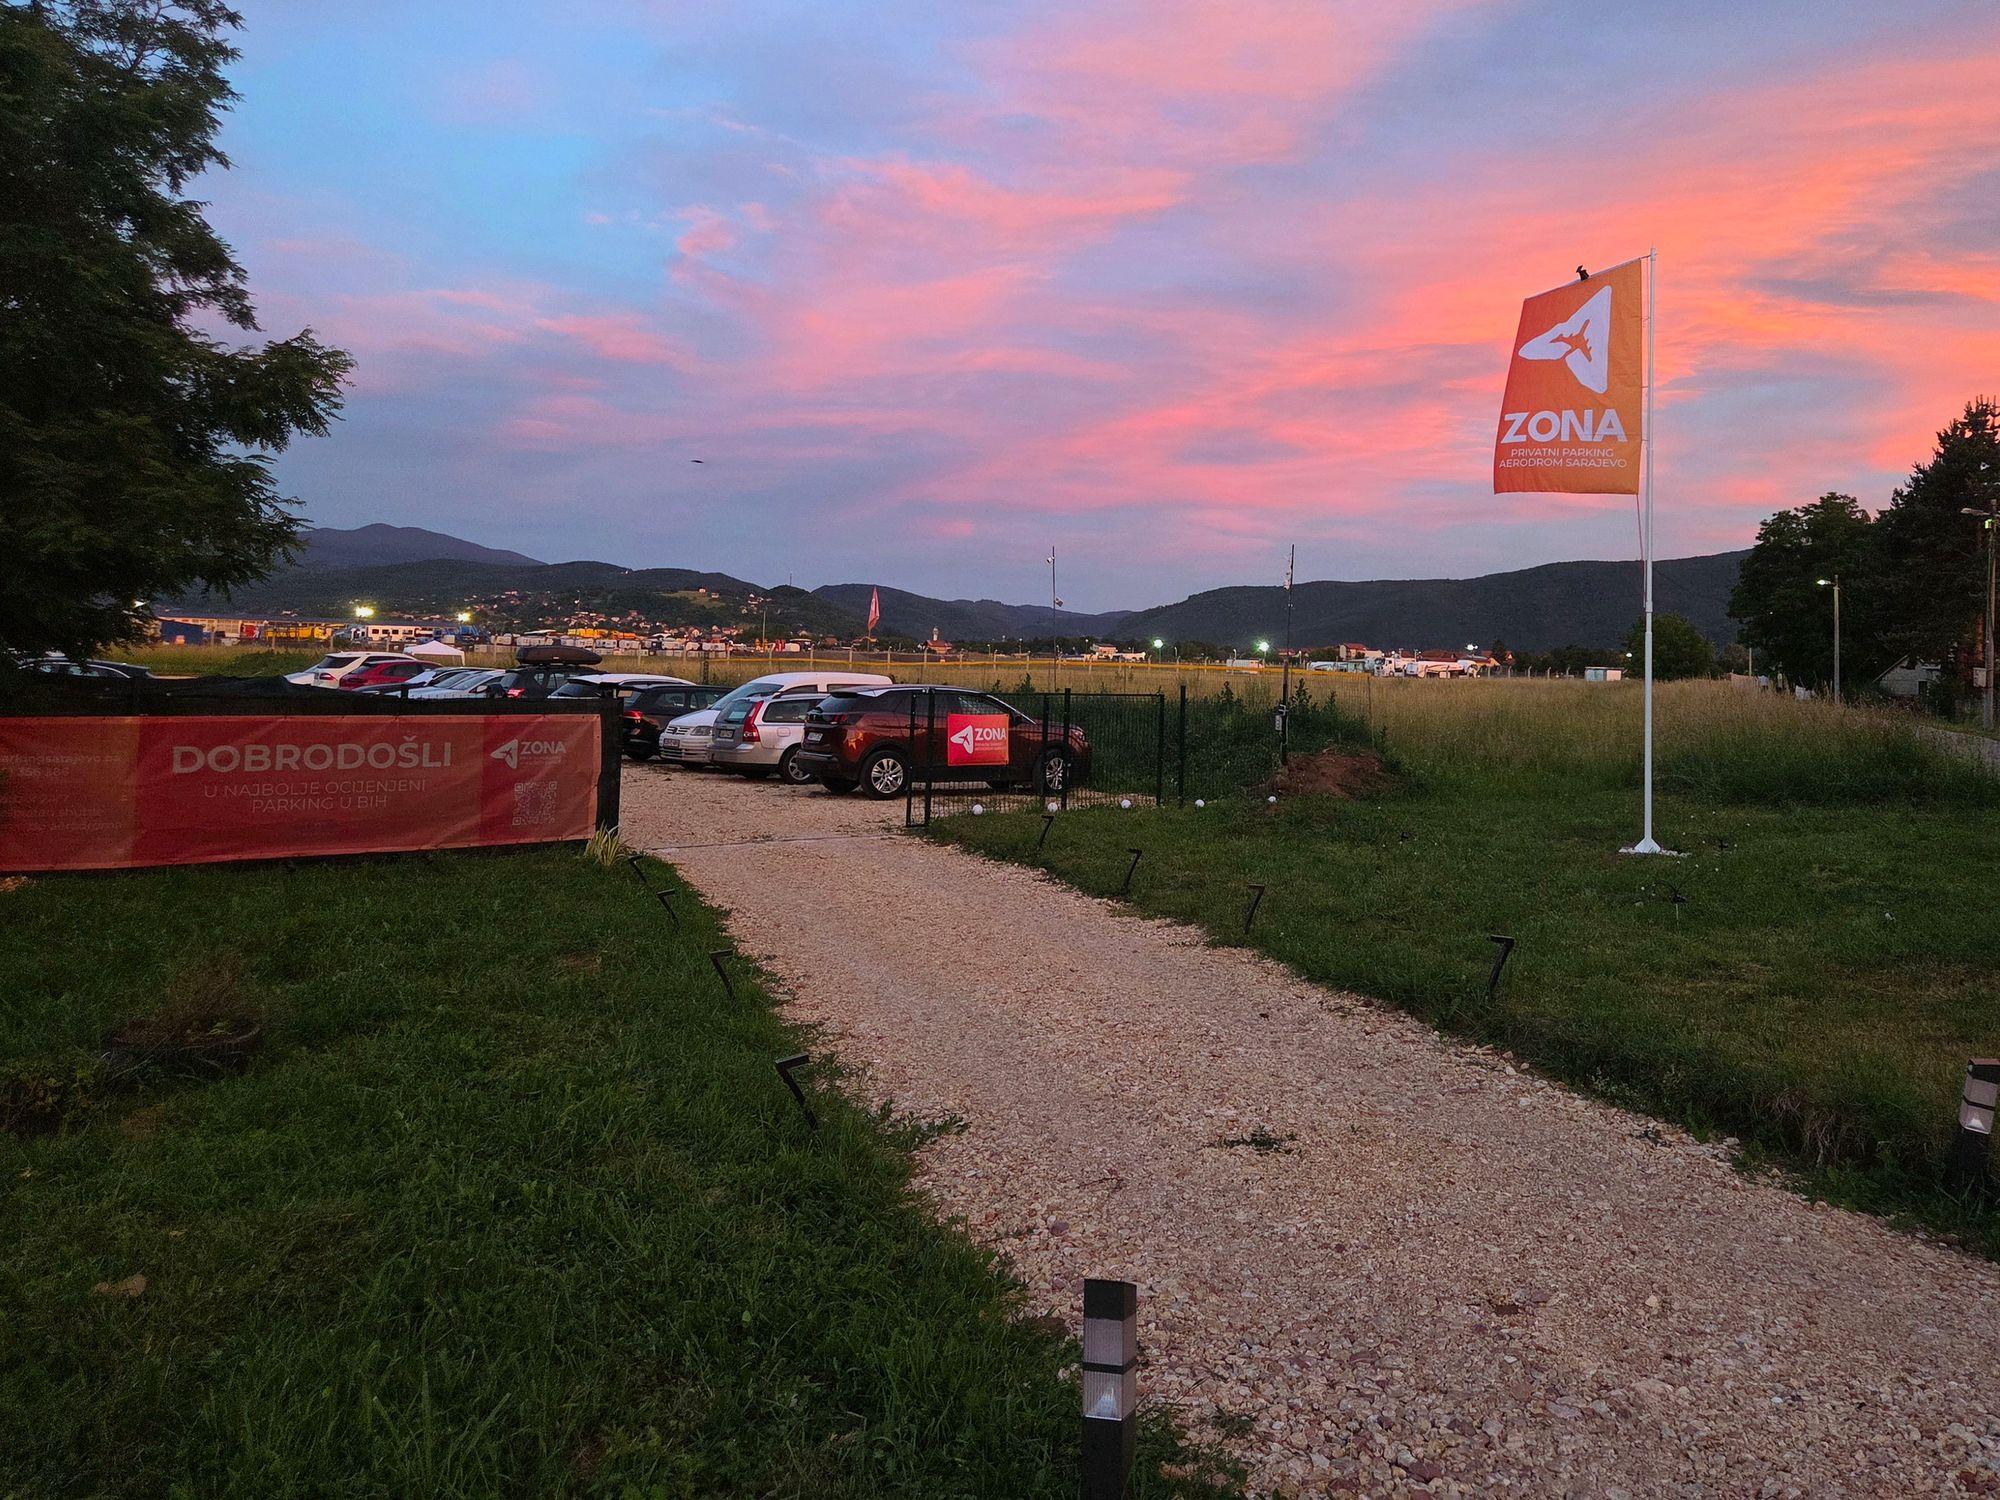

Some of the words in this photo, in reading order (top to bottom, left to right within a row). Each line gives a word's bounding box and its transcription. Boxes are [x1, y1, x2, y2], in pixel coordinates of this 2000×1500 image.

[1501, 408, 1628, 444] ZONA
[1510, 447, 1559, 458] PRIVATNI
[1562, 447, 1614, 458] PARKING
[1499, 458, 1563, 468] AERODROM
[1565, 458, 1627, 468] SARAJEVO
[974, 728, 1007, 741] ZONA
[171, 735, 453, 774] DOBRODOŠLI
[519, 740, 568, 755] ZONA
[204, 784, 217, 798] U
[223, 781, 320, 798] NAJBOLJE
[325, 779, 426, 795] OCIJENJENI
[252, 797, 335, 813] PARKING
[340, 797, 351, 810] U
[357, 795, 388, 809] BIH
